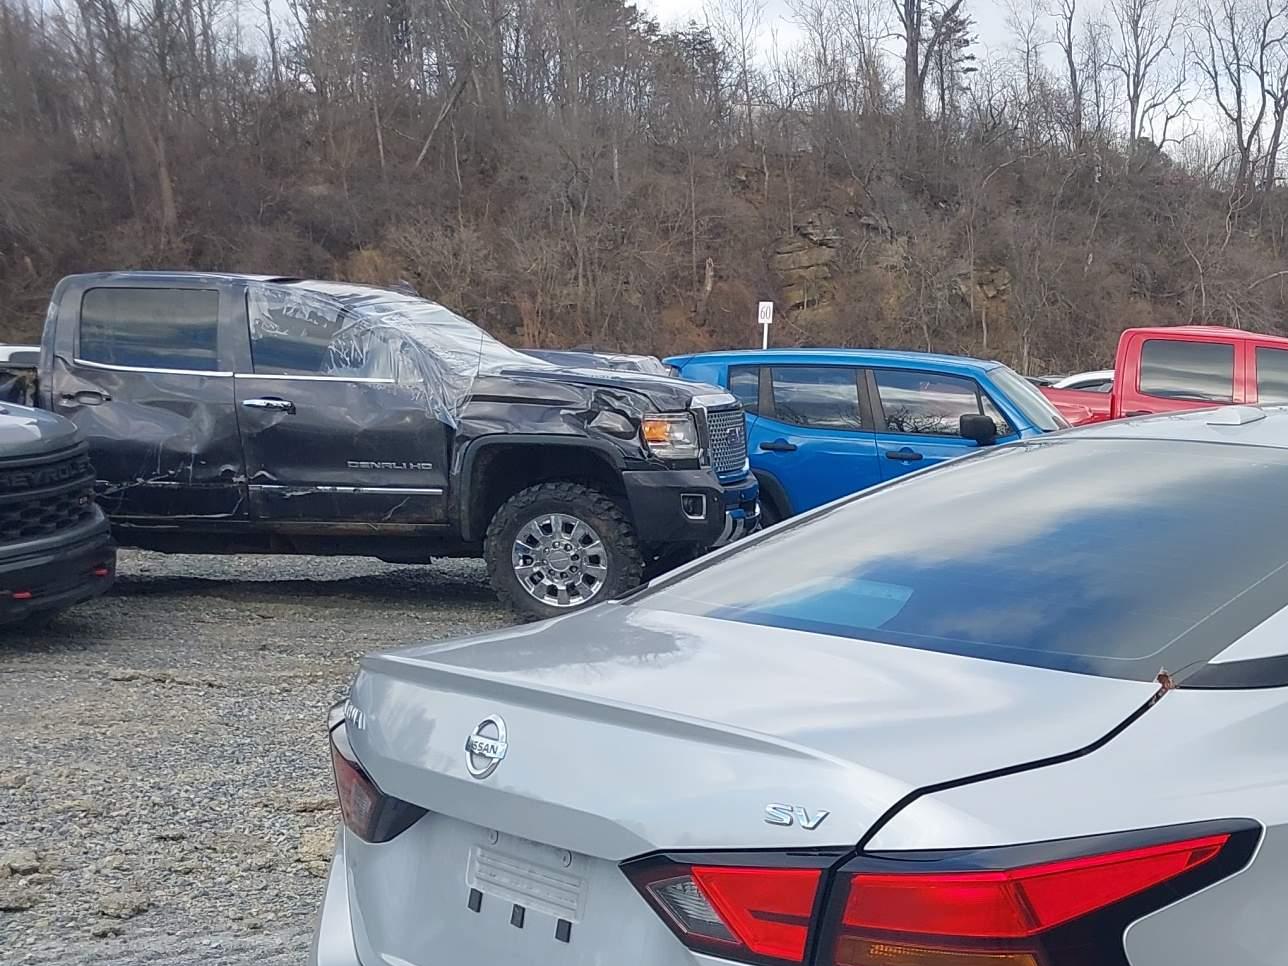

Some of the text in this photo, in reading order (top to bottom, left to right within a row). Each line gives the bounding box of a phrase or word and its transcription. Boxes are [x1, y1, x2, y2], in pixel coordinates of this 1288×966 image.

[760, 305, 772, 320] 60
[347, 461, 433, 470] DENALI HD
[764, 803, 831, 831] SV
